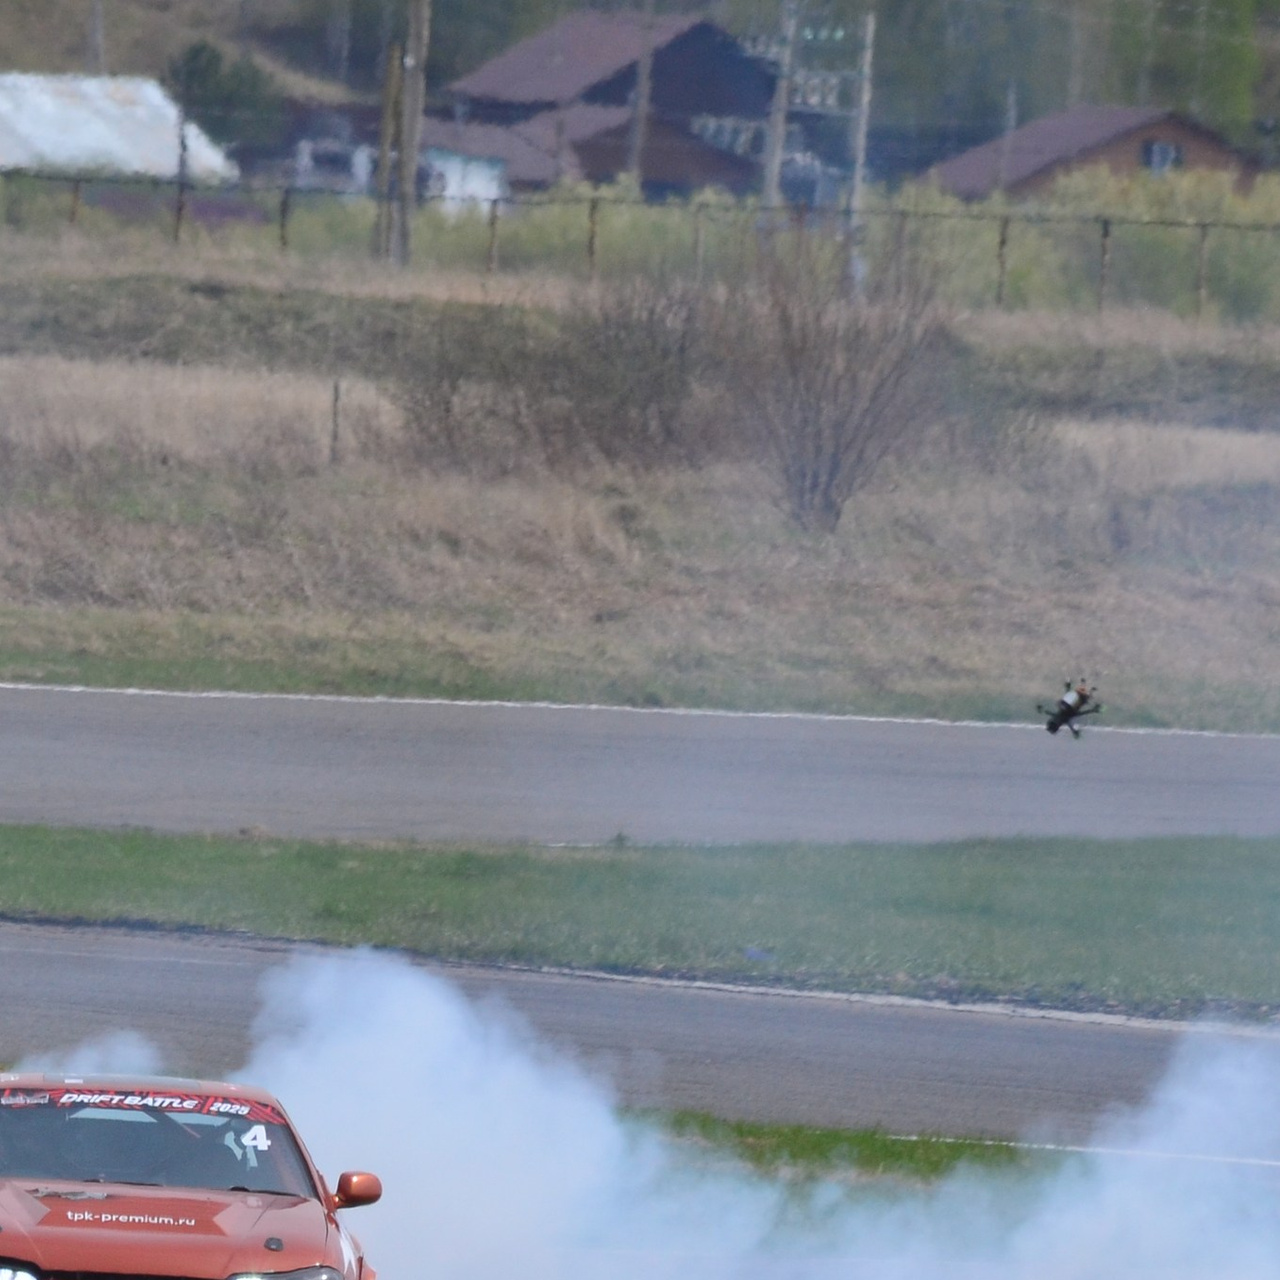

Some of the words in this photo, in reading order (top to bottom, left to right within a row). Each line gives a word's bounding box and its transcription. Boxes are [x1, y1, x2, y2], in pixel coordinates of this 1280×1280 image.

[60, 1093, 125, 1104] DRIFT
[123, 1096, 199, 1109] BATTLE
[210, 1102, 250, 1115] 2025
[241, 1124, 271, 1151] 4
[66, 1210, 196, 1227] tpk-premium.ru
